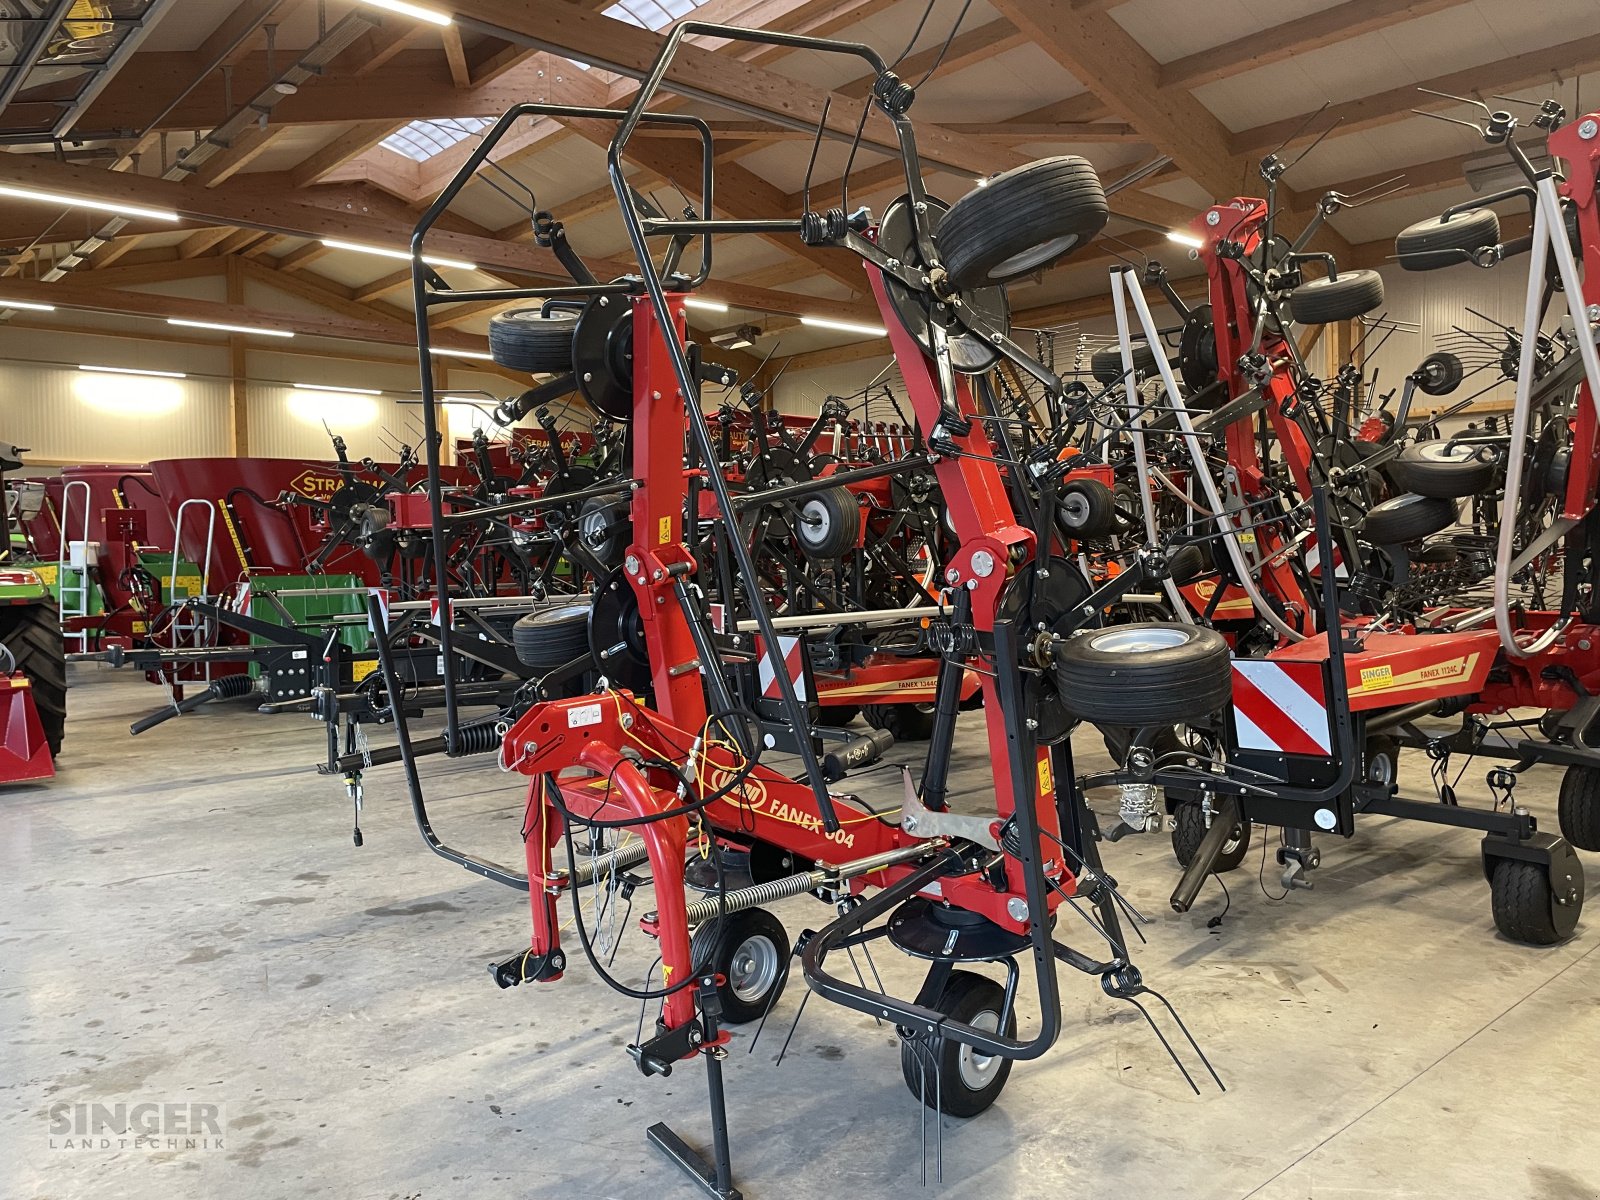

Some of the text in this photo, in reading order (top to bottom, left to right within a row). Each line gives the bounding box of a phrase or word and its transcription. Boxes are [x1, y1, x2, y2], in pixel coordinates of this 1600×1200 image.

[1361, 667, 1390, 680] SINGER
[1420, 665, 1457, 679] FANEX 1124C
[898, 681, 919, 689] FANEX
[769, 799, 823, 835] FANEX
